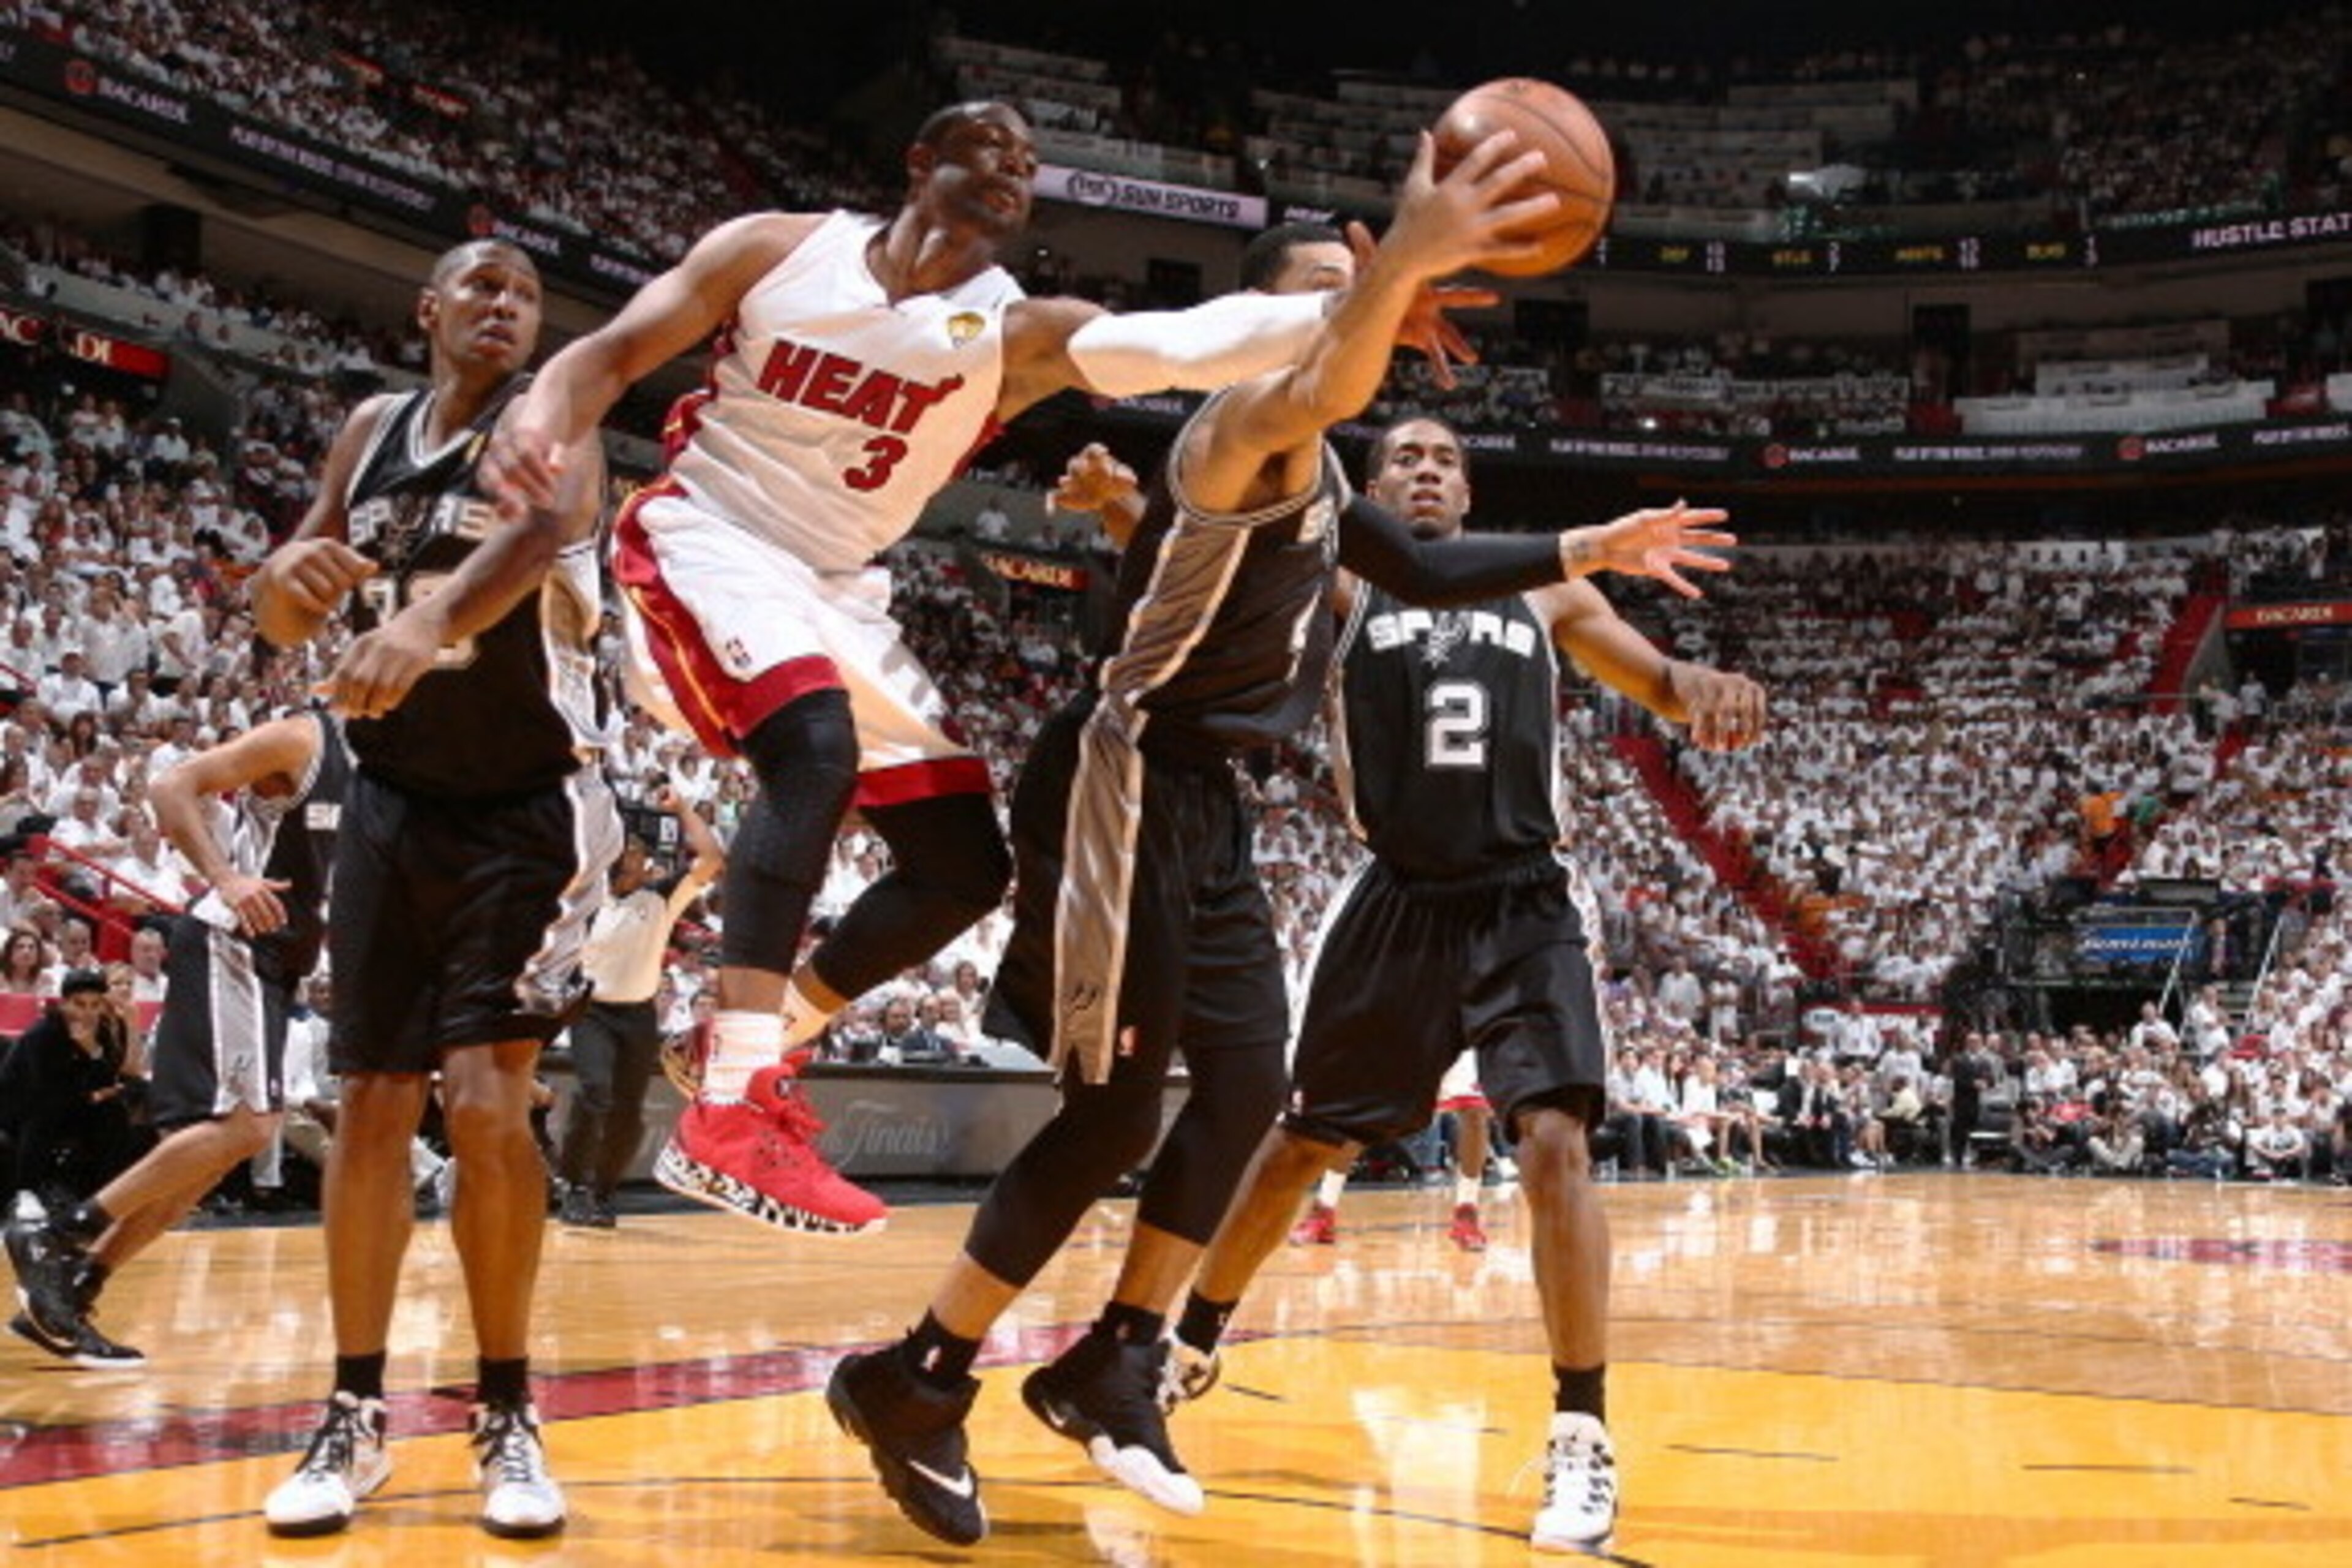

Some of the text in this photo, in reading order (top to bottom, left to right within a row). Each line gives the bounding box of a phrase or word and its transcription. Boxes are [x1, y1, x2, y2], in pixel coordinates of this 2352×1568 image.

[1164, 187, 1240, 217] SPORTS
[2192, 221, 2285, 248] HUSTLE
[757, 337, 965, 434] HEAT
[842, 435, 908, 491] 3
[1426, 681, 1490, 771] 2
